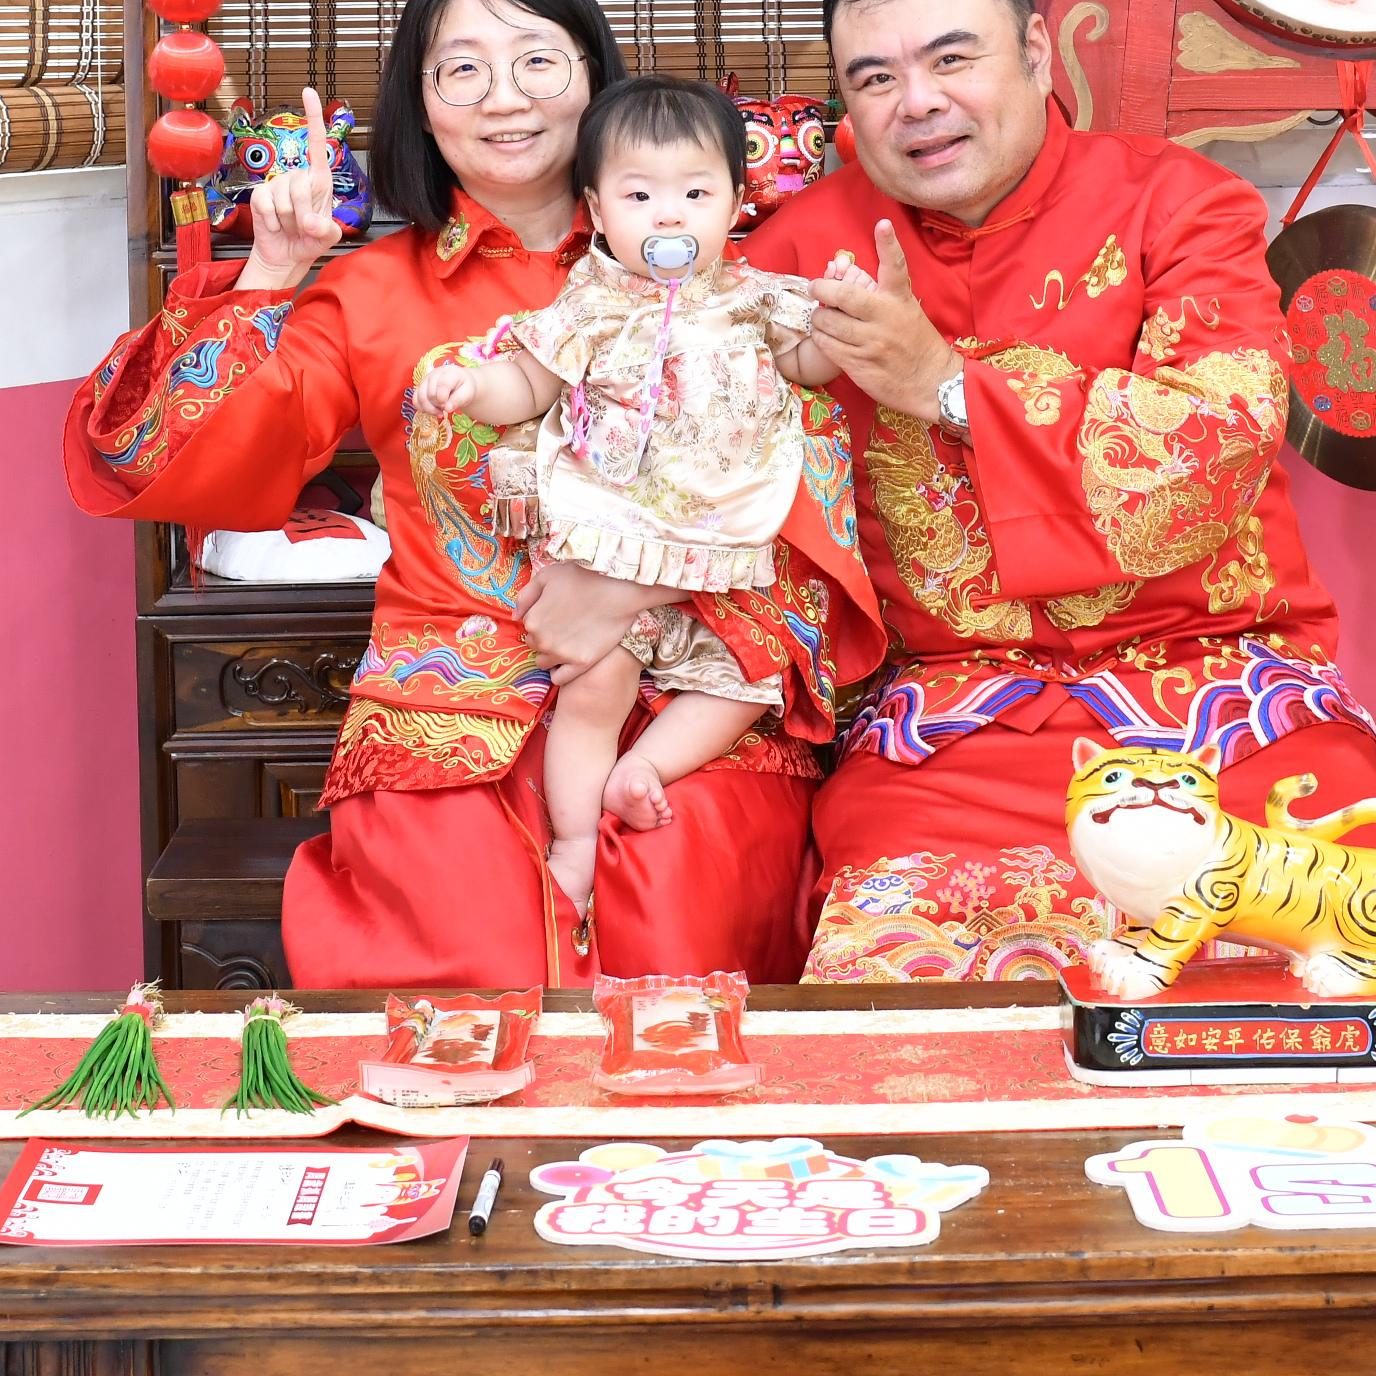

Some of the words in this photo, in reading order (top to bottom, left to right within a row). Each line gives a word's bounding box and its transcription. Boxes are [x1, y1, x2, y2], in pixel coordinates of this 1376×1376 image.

[612, 1178, 891, 1209] 今天是
[556, 1204, 919, 1236] 我的生日
